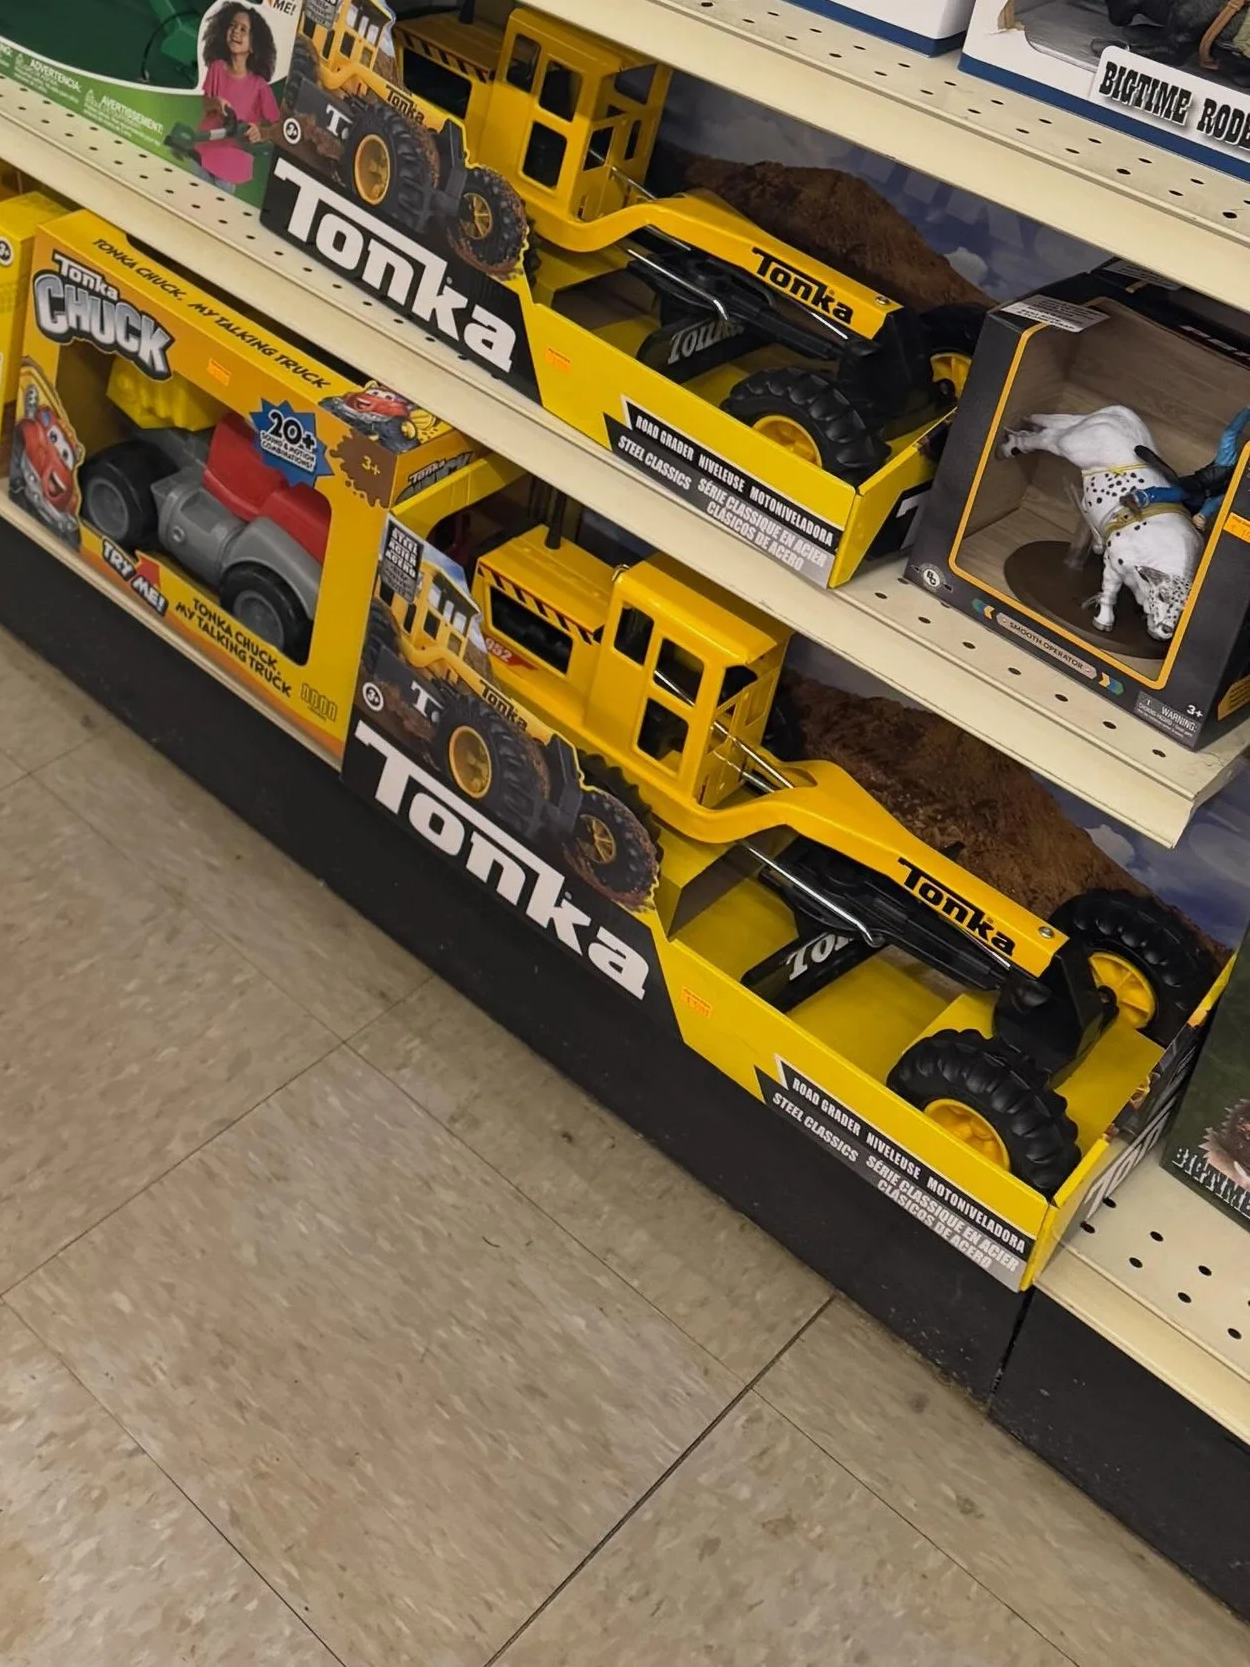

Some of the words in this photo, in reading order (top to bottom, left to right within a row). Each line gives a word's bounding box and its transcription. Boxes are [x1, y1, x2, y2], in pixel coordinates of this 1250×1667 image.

[385, 84, 426, 125] Tonka
[1098, 60, 1193, 125] BIGTIME
[1196, 97, 1250, 152] RODE
[53, 253, 119, 301] Tonka
[274, 157, 518, 373] Tonka
[751, 247, 854, 326] Tonka
[34, 273, 173, 374] CHUCK
[92, 237, 136, 274] TONKA
[187, 300, 215, 323] MY
[215, 312, 277, 360] TALKING
[274, 344, 332, 390] TRUCK
[266, 410, 316, 453] 20+
[360, 455, 382, 477] 3+
[618, 435, 645, 467] STEEL
[644, 451, 692, 492] CLASSICS
[697, 477, 726, 510] SÉRIE
[726, 492, 782, 540] CLASSIQUE
[782, 525, 798, 550] EN
[798, 534, 828, 568] ACIER
[635, 414, 658, 444] ROAD
[658, 427, 694, 462] GRADER
[698, 452, 745, 494] NIVELEUSE
[749, 485, 833, 549] MOTONIVELADORA
[102, 539, 133, 578] TRY
[706, 499, 755, 542] CLÁSICOS
[755, 531, 771, 551] DE
[771, 540, 805, 572] ACERO
[133, 574, 168, 615] ME!
[175, 602, 196, 625] MY
[194, 616, 248, 668] TALKING
[247, 654, 292, 698] TRUCK
[191, 597, 233, 638] TONKA
[232, 626, 280, 677] CHUCK.
[1009, 621, 1041, 646] SMOOTH
[1041, 640, 1085, 672] OPERATOR
[479, 679, 529, 731] Tonka
[1161, 706, 1198, 732] WARNING:
[1186, 704, 1203, 718] 3+
[355, 719, 650, 1001] Tonka
[897, 857, 1015, 957] Tonka
[772, 1091, 804, 1124] STEEL
[803, 1111, 859, 1163] CLASSICS
[865, 1154, 899, 1186] SÉRIE
[899, 1174, 965, 1230] CLASSIQUE
[964, 1221, 984, 1242] EN
[984, 1231, 1020, 1272] ACIER
[792, 1078, 819, 1106] ROAD
[820, 1094, 861, 1137] GRADER
[865, 1131, 921, 1179] NIVELEUSE
[926, 1174, 1026, 1254] MOTONIVELADORA
[1172, 1146, 1250, 1220] BIGTIM
[876, 1179, 934, 1227] CLÁSICOS
[934, 1218, 954, 1242] DE
[954, 1231, 992, 1270] ACERO
